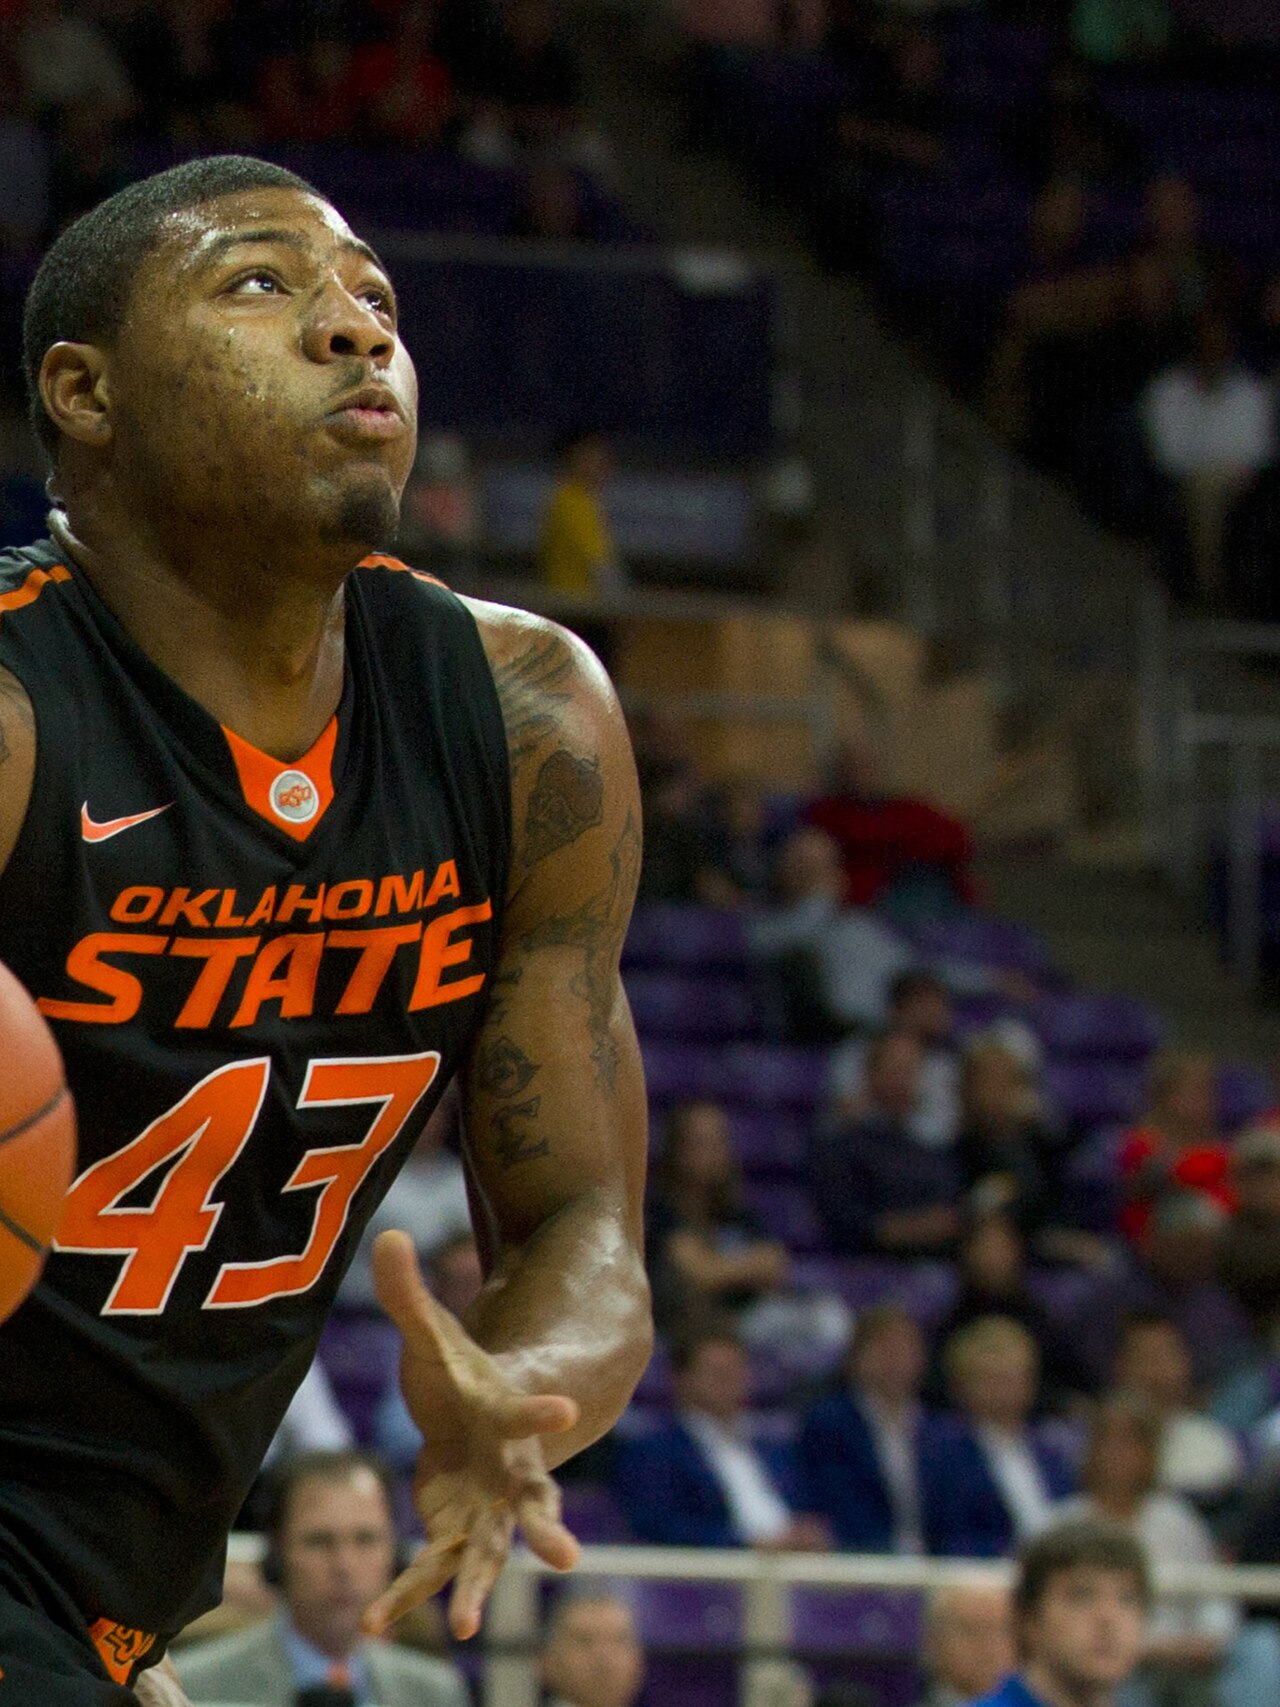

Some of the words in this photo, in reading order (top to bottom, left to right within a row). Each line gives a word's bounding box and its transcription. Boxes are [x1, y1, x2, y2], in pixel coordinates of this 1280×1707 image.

[109, 859, 461, 929] OKLAHOMA
[36, 897, 493, 1030] STATE
[51, 1050, 442, 1316] 43
